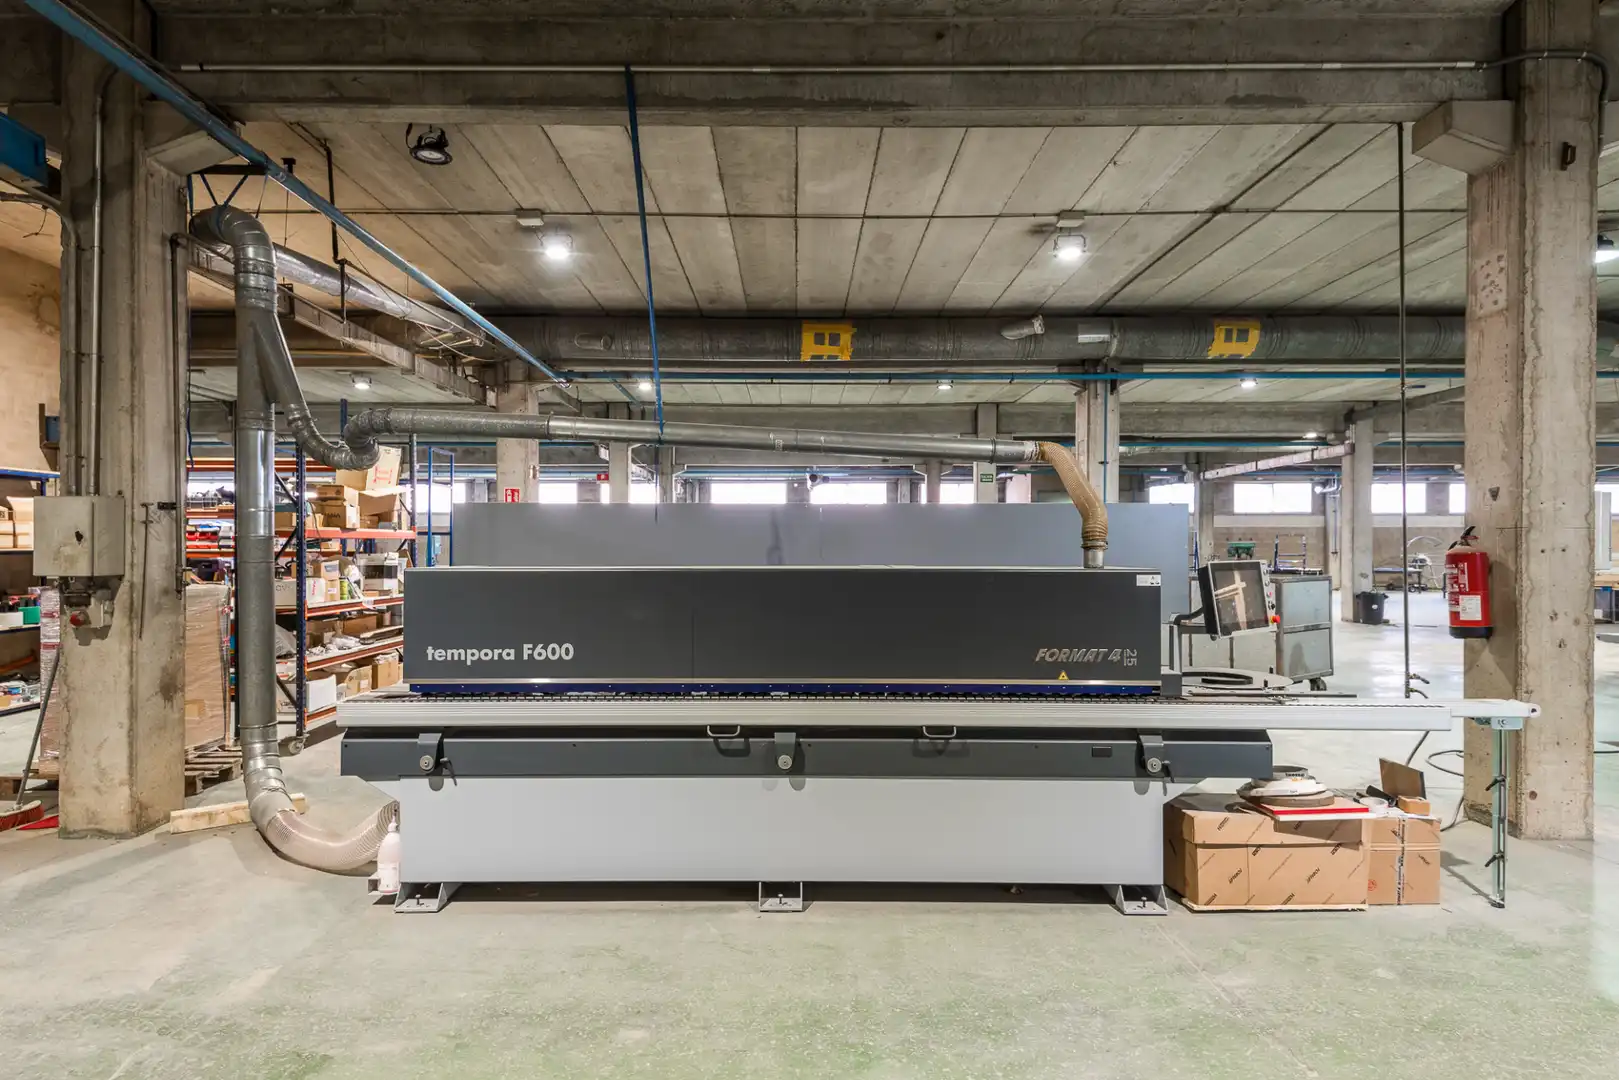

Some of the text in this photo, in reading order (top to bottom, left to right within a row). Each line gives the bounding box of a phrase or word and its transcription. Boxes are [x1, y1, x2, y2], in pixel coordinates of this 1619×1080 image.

[426, 643, 575, 666] tempora F600
[1035, 648, 1109, 663] FORMAT
[1108, 648, 1123, 663] 4
